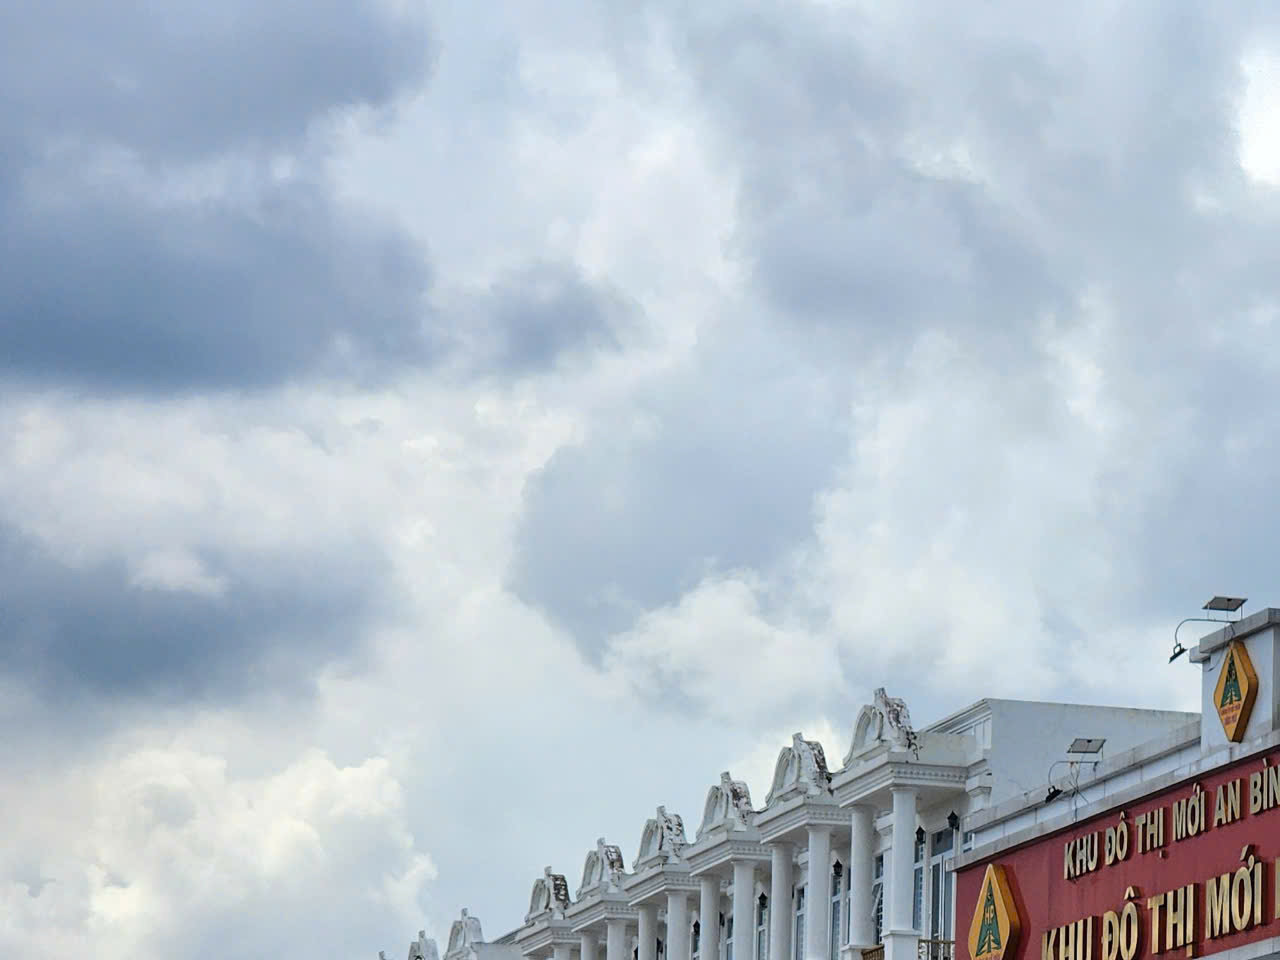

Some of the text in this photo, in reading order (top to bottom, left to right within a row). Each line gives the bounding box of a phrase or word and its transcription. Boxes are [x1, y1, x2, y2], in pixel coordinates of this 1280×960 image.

[1064, 831, 1099, 880] KHU
[1104, 811, 1129, 866] ĐÔ
[1135, 807, 1165, 858] THỊ
[1172, 783, 1206, 841] MỚI
[1213, 778, 1242, 827] AN
[1147, 883, 1195, 958] THỊ
[1205, 845, 1263, 940] MỚI
